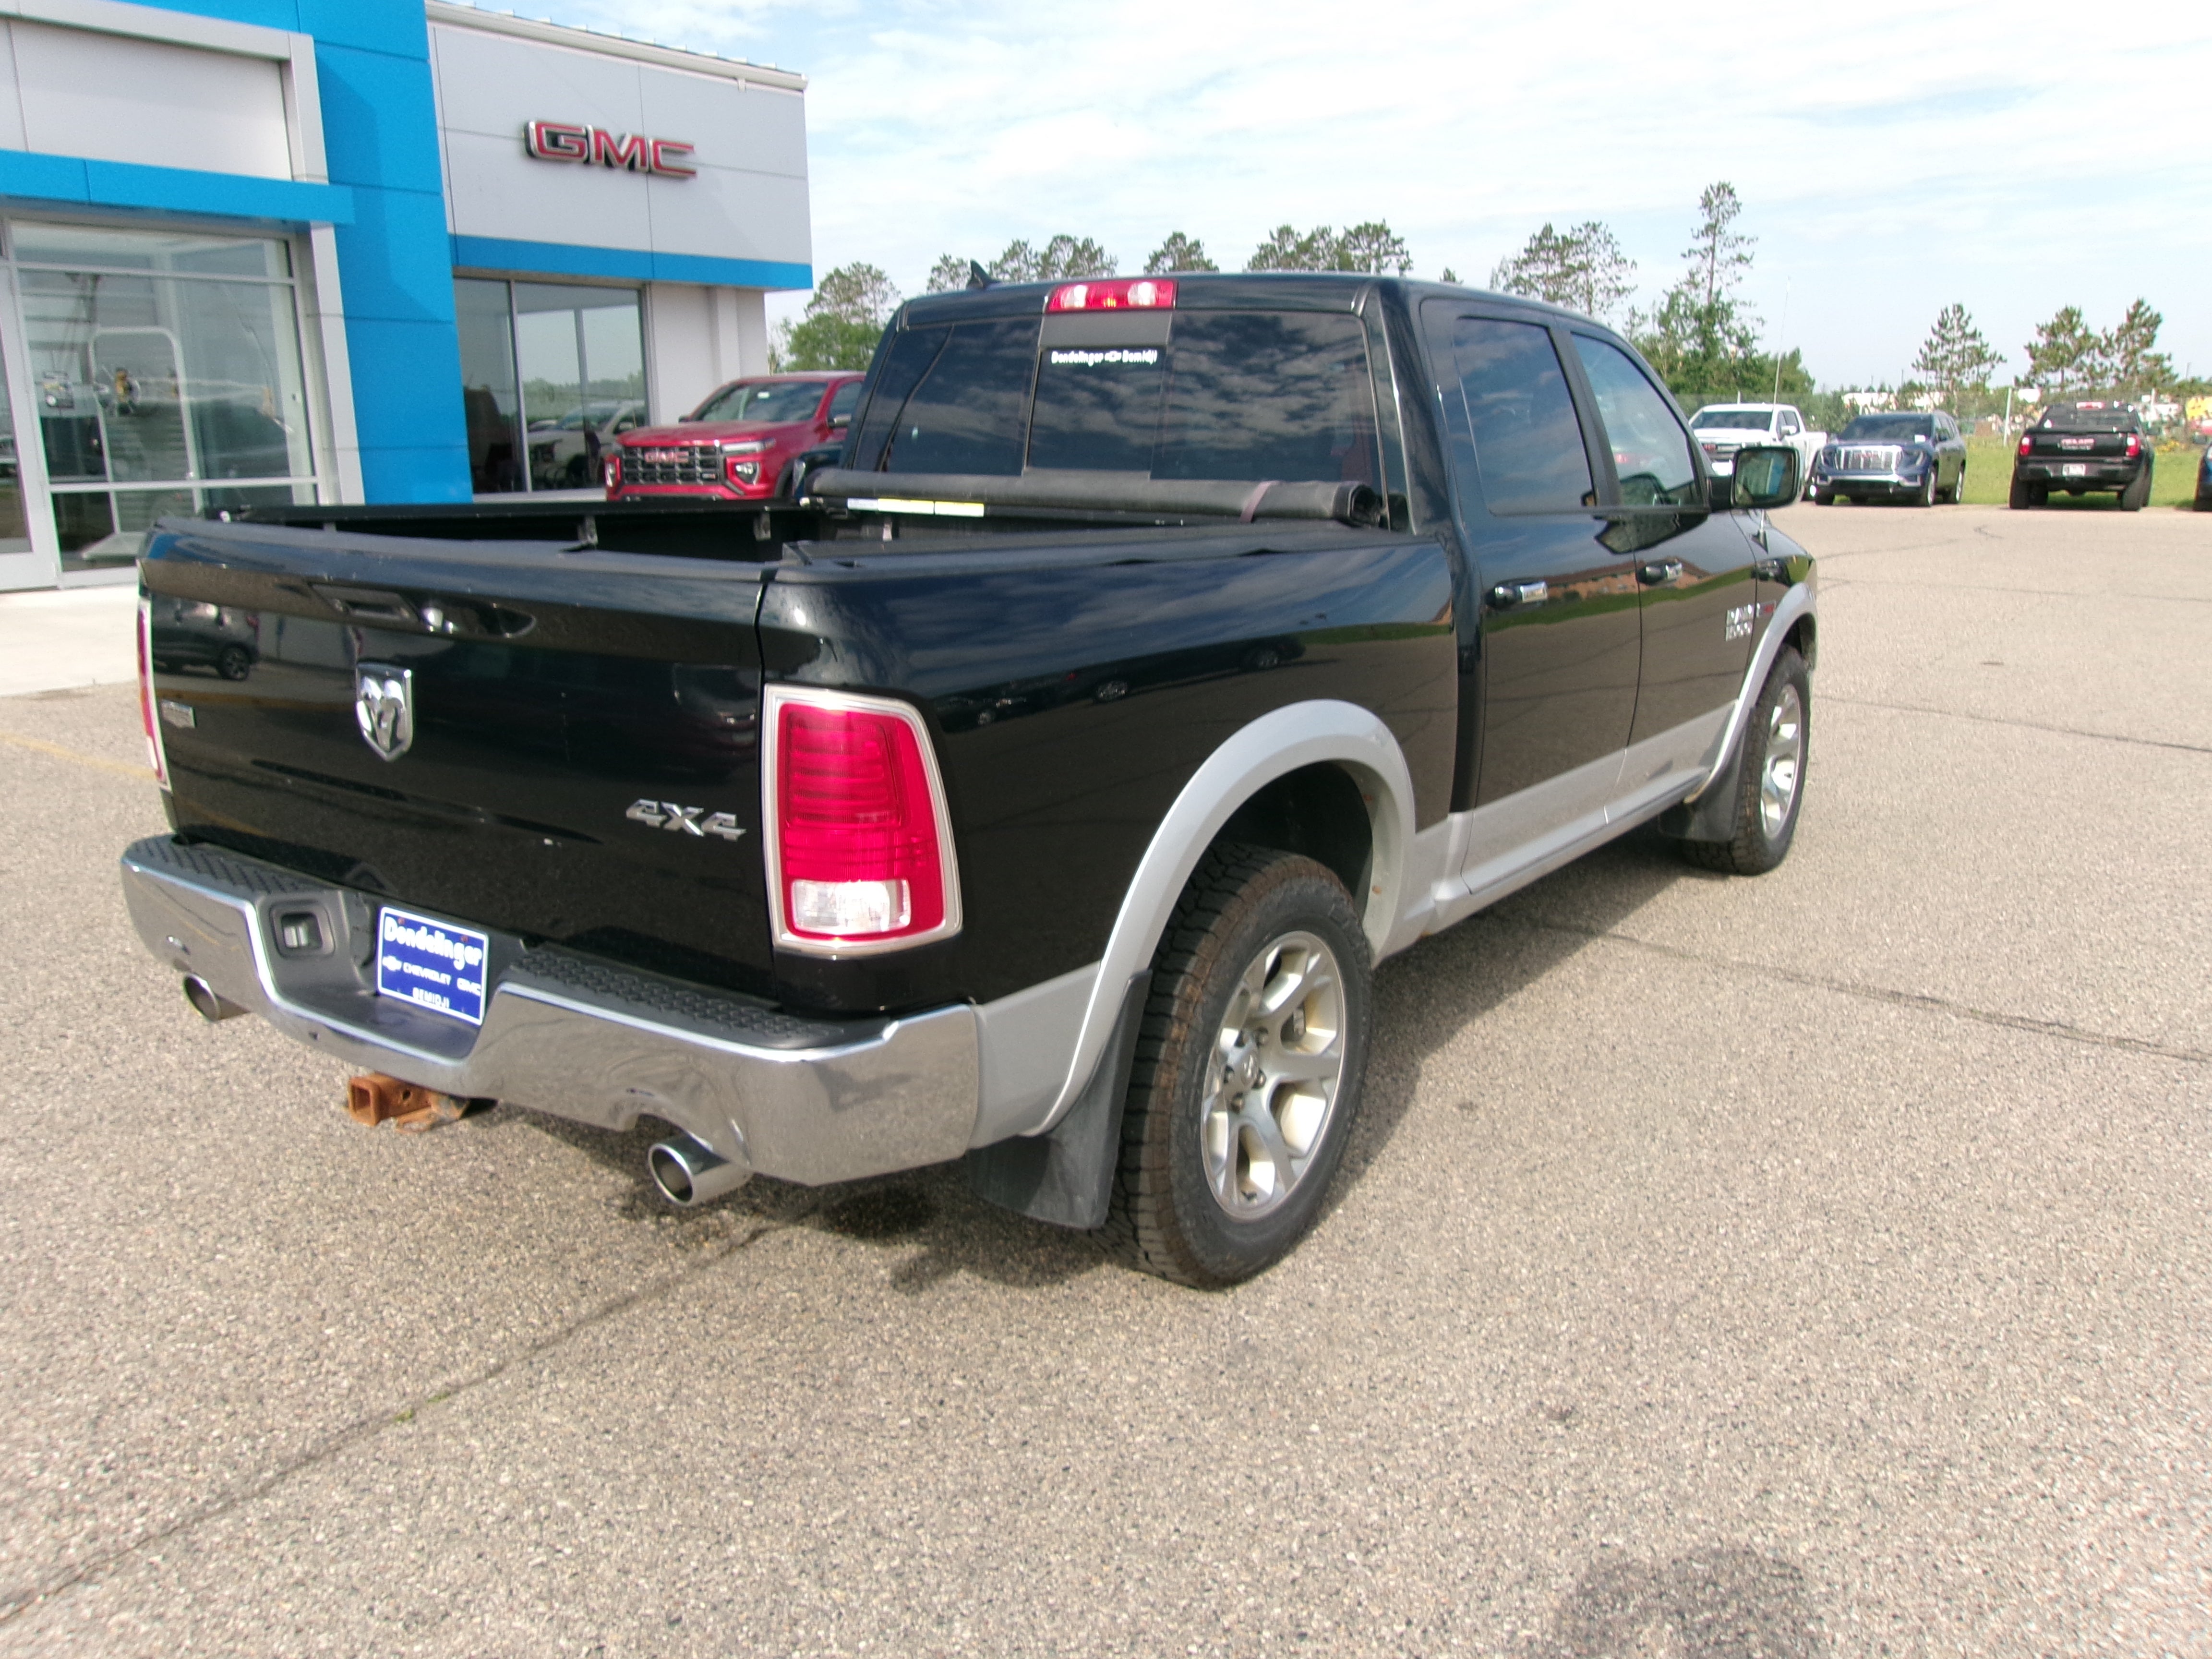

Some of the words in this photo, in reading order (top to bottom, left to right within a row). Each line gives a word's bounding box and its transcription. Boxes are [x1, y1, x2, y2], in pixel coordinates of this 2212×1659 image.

[524, 121, 697, 179] GMC
[644, 451, 689, 463] GMC
[384, 916, 482, 971] Dondelinger
[403, 962, 452, 986] CHEVROLET
[457, 977, 481, 997] GMC
[412, 987, 450, 1009] BEMIDJI
